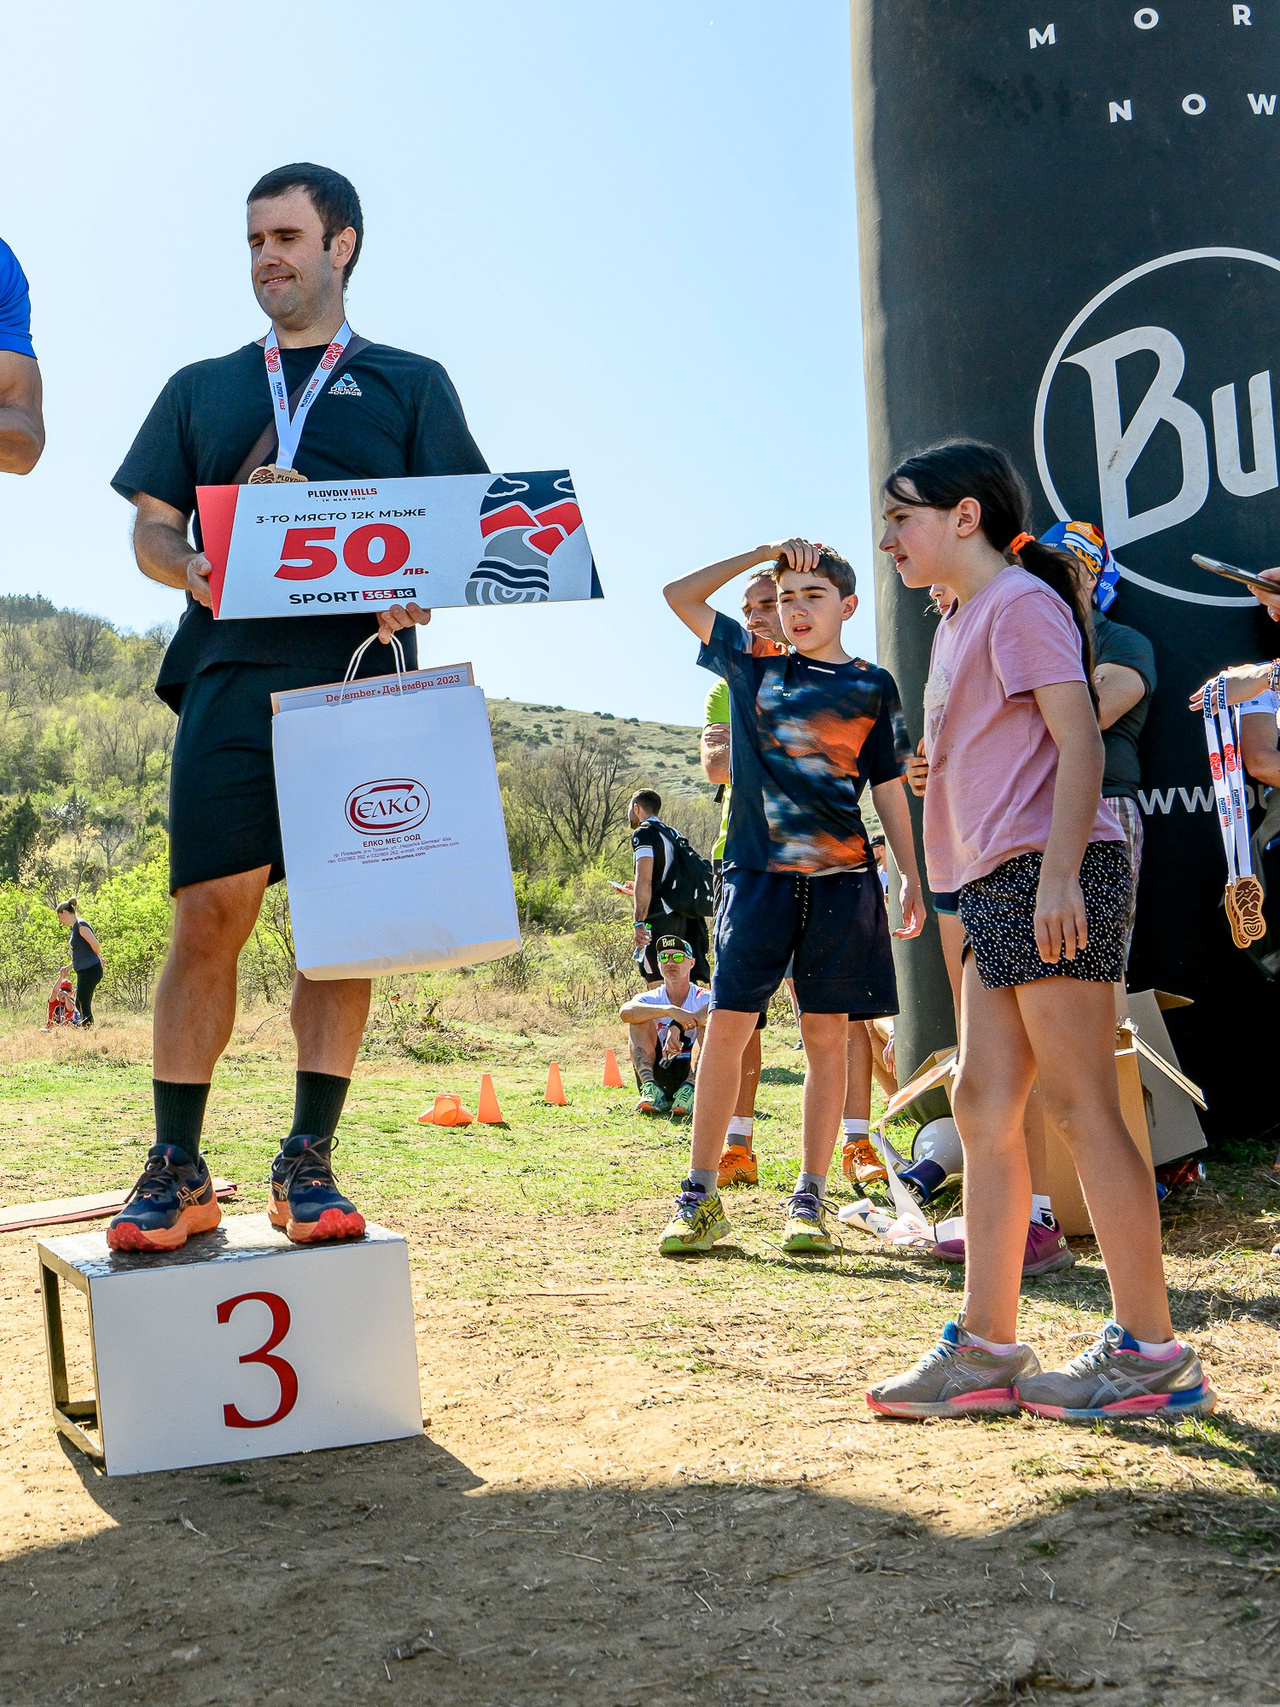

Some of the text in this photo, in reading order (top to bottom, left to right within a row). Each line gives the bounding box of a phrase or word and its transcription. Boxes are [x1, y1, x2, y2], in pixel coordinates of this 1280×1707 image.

[307, 487, 378, 499] PLOVDIV HILLS
[255, 513, 291, 525] 3-ТО
[293, 511, 347, 523] МЯСТО
[379, 508, 427, 519] МЪЖЕ
[273, 522, 411, 581] 50
[289, 588, 414, 605] SPORT 365.BG
[436, 674, 460, 686] 2023
[363, 839, 384, 847] ЕЛКО
[386, 836, 402, 844] МЕС
[216, 1290, 300, 1429] 3
